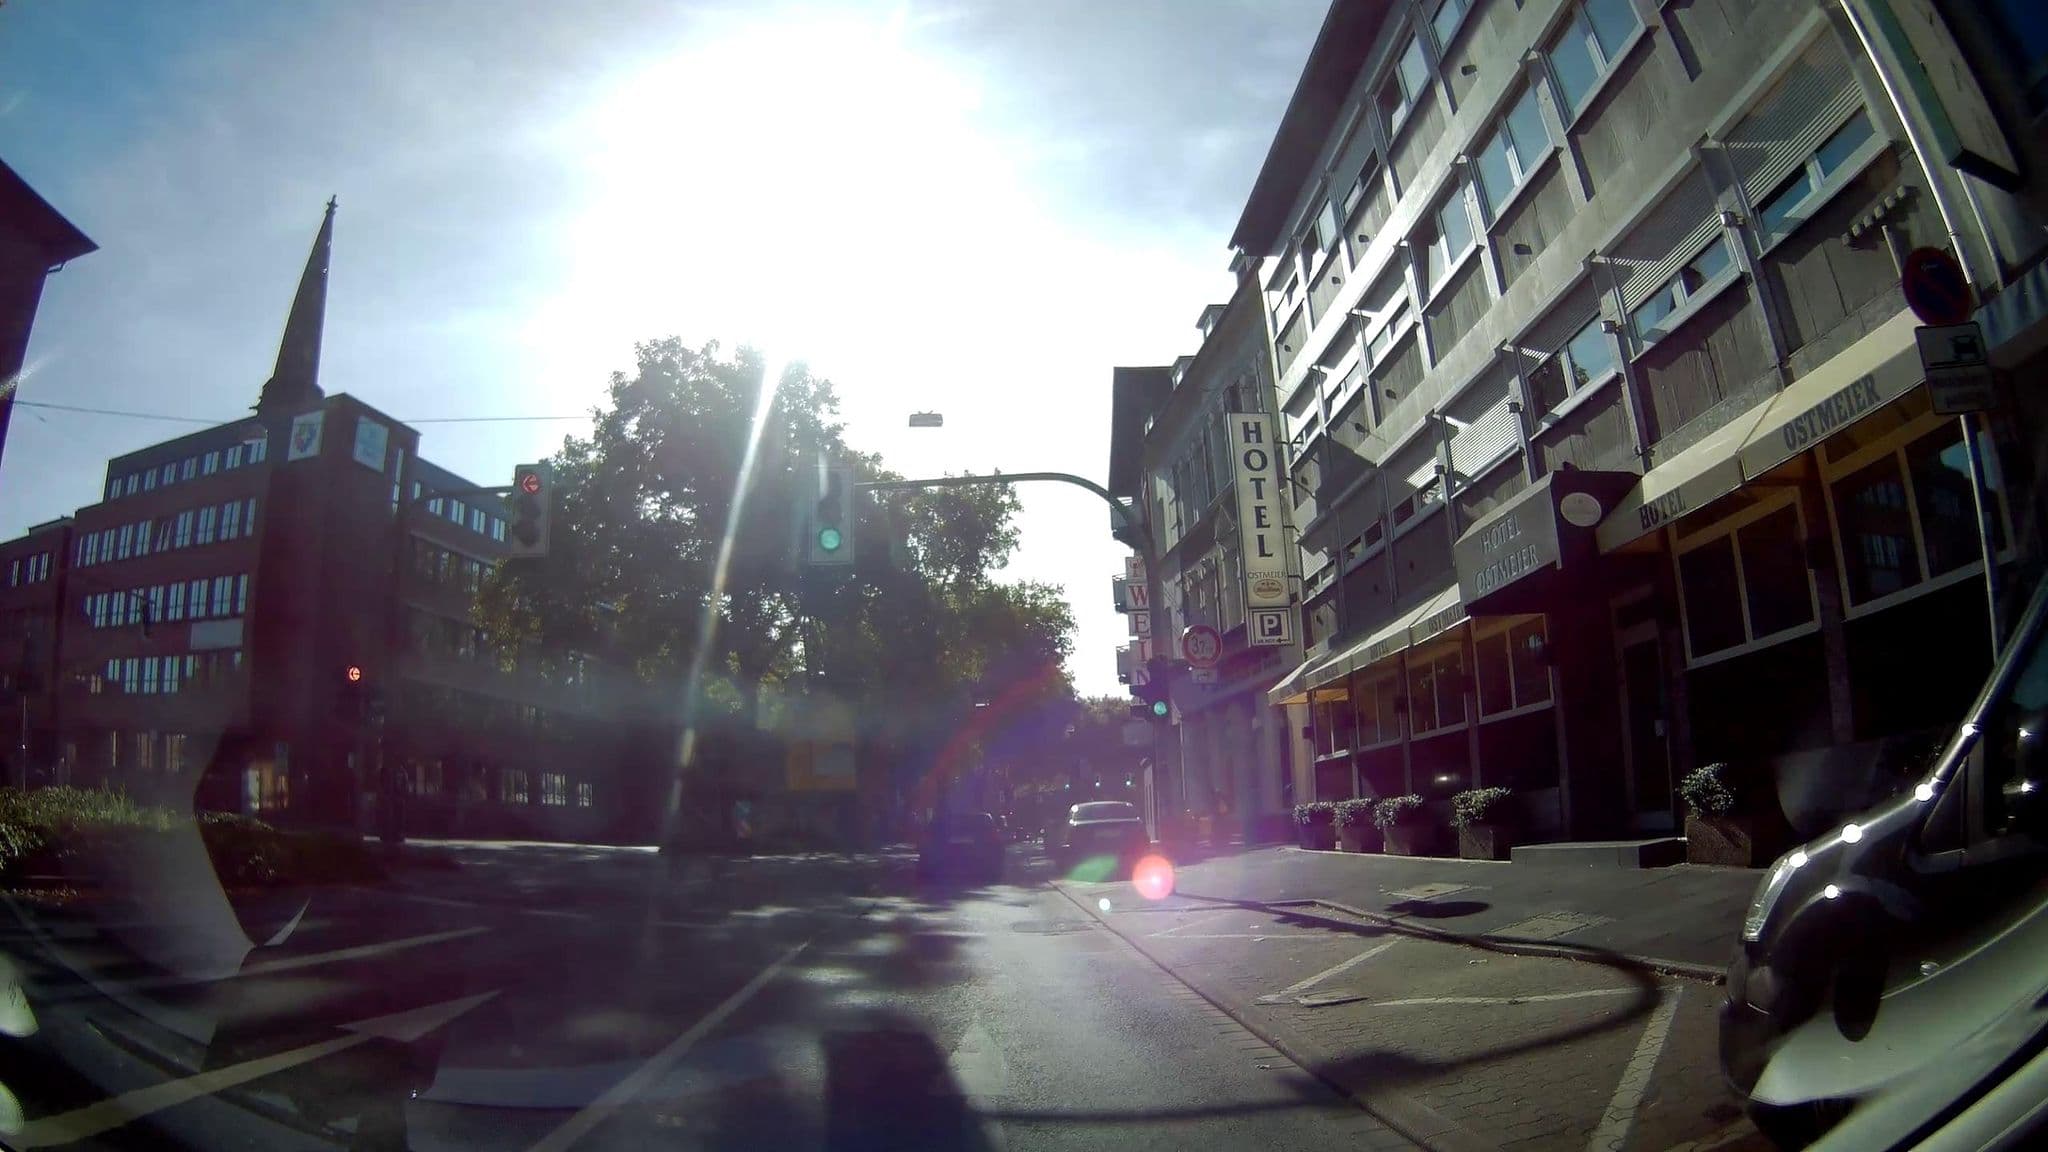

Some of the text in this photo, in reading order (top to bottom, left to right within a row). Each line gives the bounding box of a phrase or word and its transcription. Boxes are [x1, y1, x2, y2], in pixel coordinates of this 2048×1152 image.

[1782, 373, 1881, 451] OSTMEIER
[1241, 421, 1273, 558] HOTEL
[1639, 486, 1687, 530] HOTEL
[1479, 513, 1523, 555] HOTEL
[1473, 544, 1539, 594] OSTMEIER
[1263, 615, 1279, 635] P
